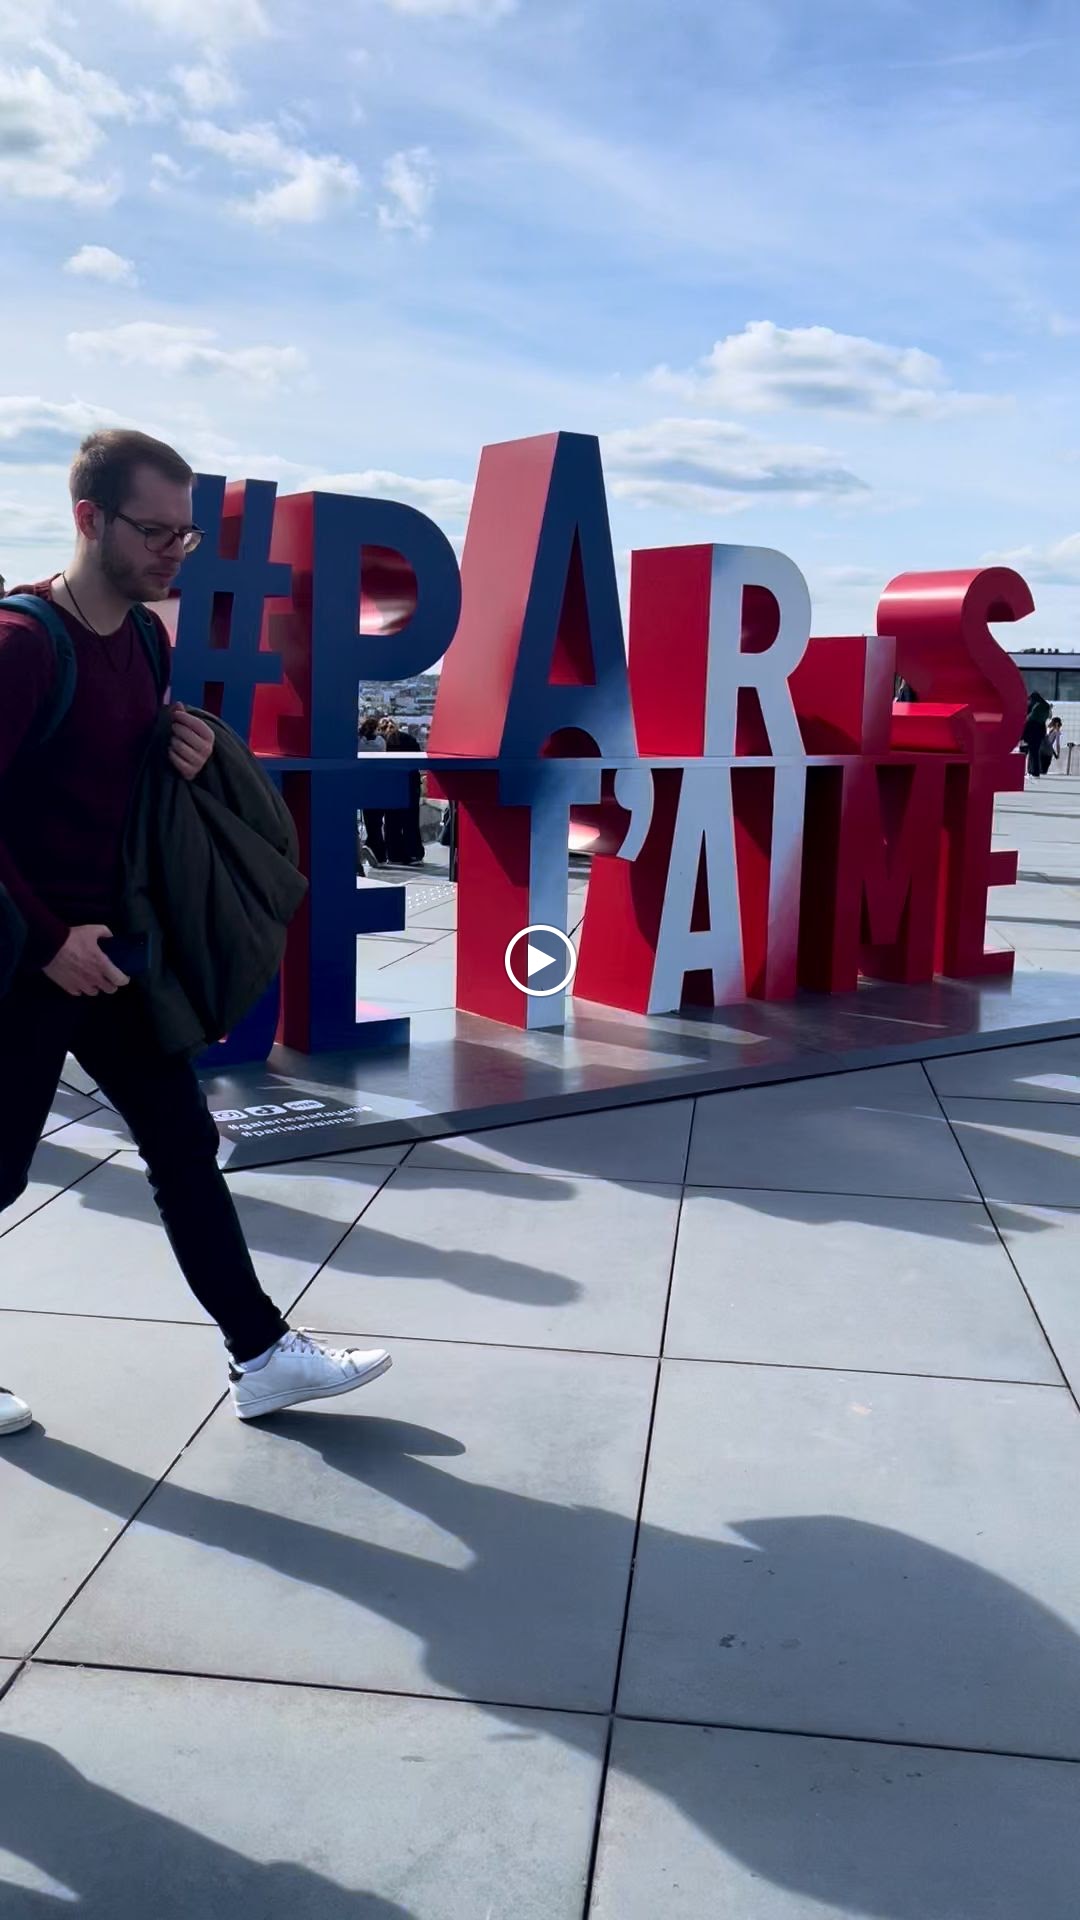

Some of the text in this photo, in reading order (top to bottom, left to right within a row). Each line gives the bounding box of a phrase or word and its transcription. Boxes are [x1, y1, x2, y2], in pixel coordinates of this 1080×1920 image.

[172, 431, 1035, 759] #PARIS
[196, 754, 1026, 1066] E T'AIME
